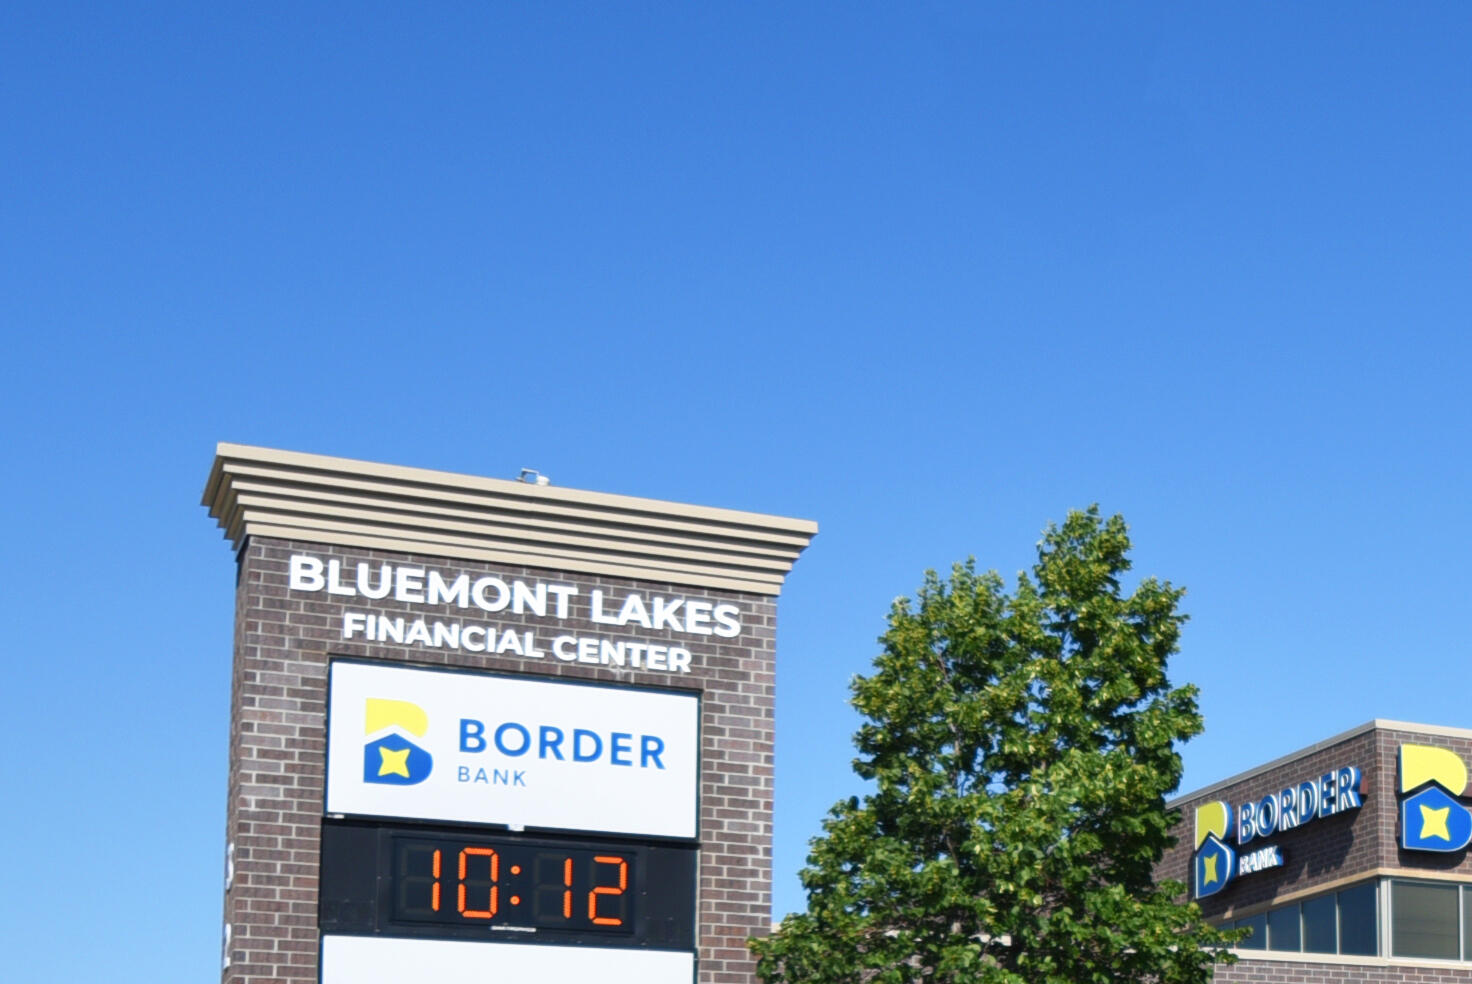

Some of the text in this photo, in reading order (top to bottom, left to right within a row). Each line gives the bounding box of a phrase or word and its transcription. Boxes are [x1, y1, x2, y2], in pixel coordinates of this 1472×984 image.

[289, 554, 741, 638] BLUEMONT LAKES
[343, 612, 692, 673] FINANCIAL CENTER
[458, 718, 666, 770] BORDER
[457, 765, 527, 788] BANK
[1238, 766, 1362, 845] BORDER
[431, 847, 628, 926] 10:12
[1239, 845, 1284, 876] BANK
